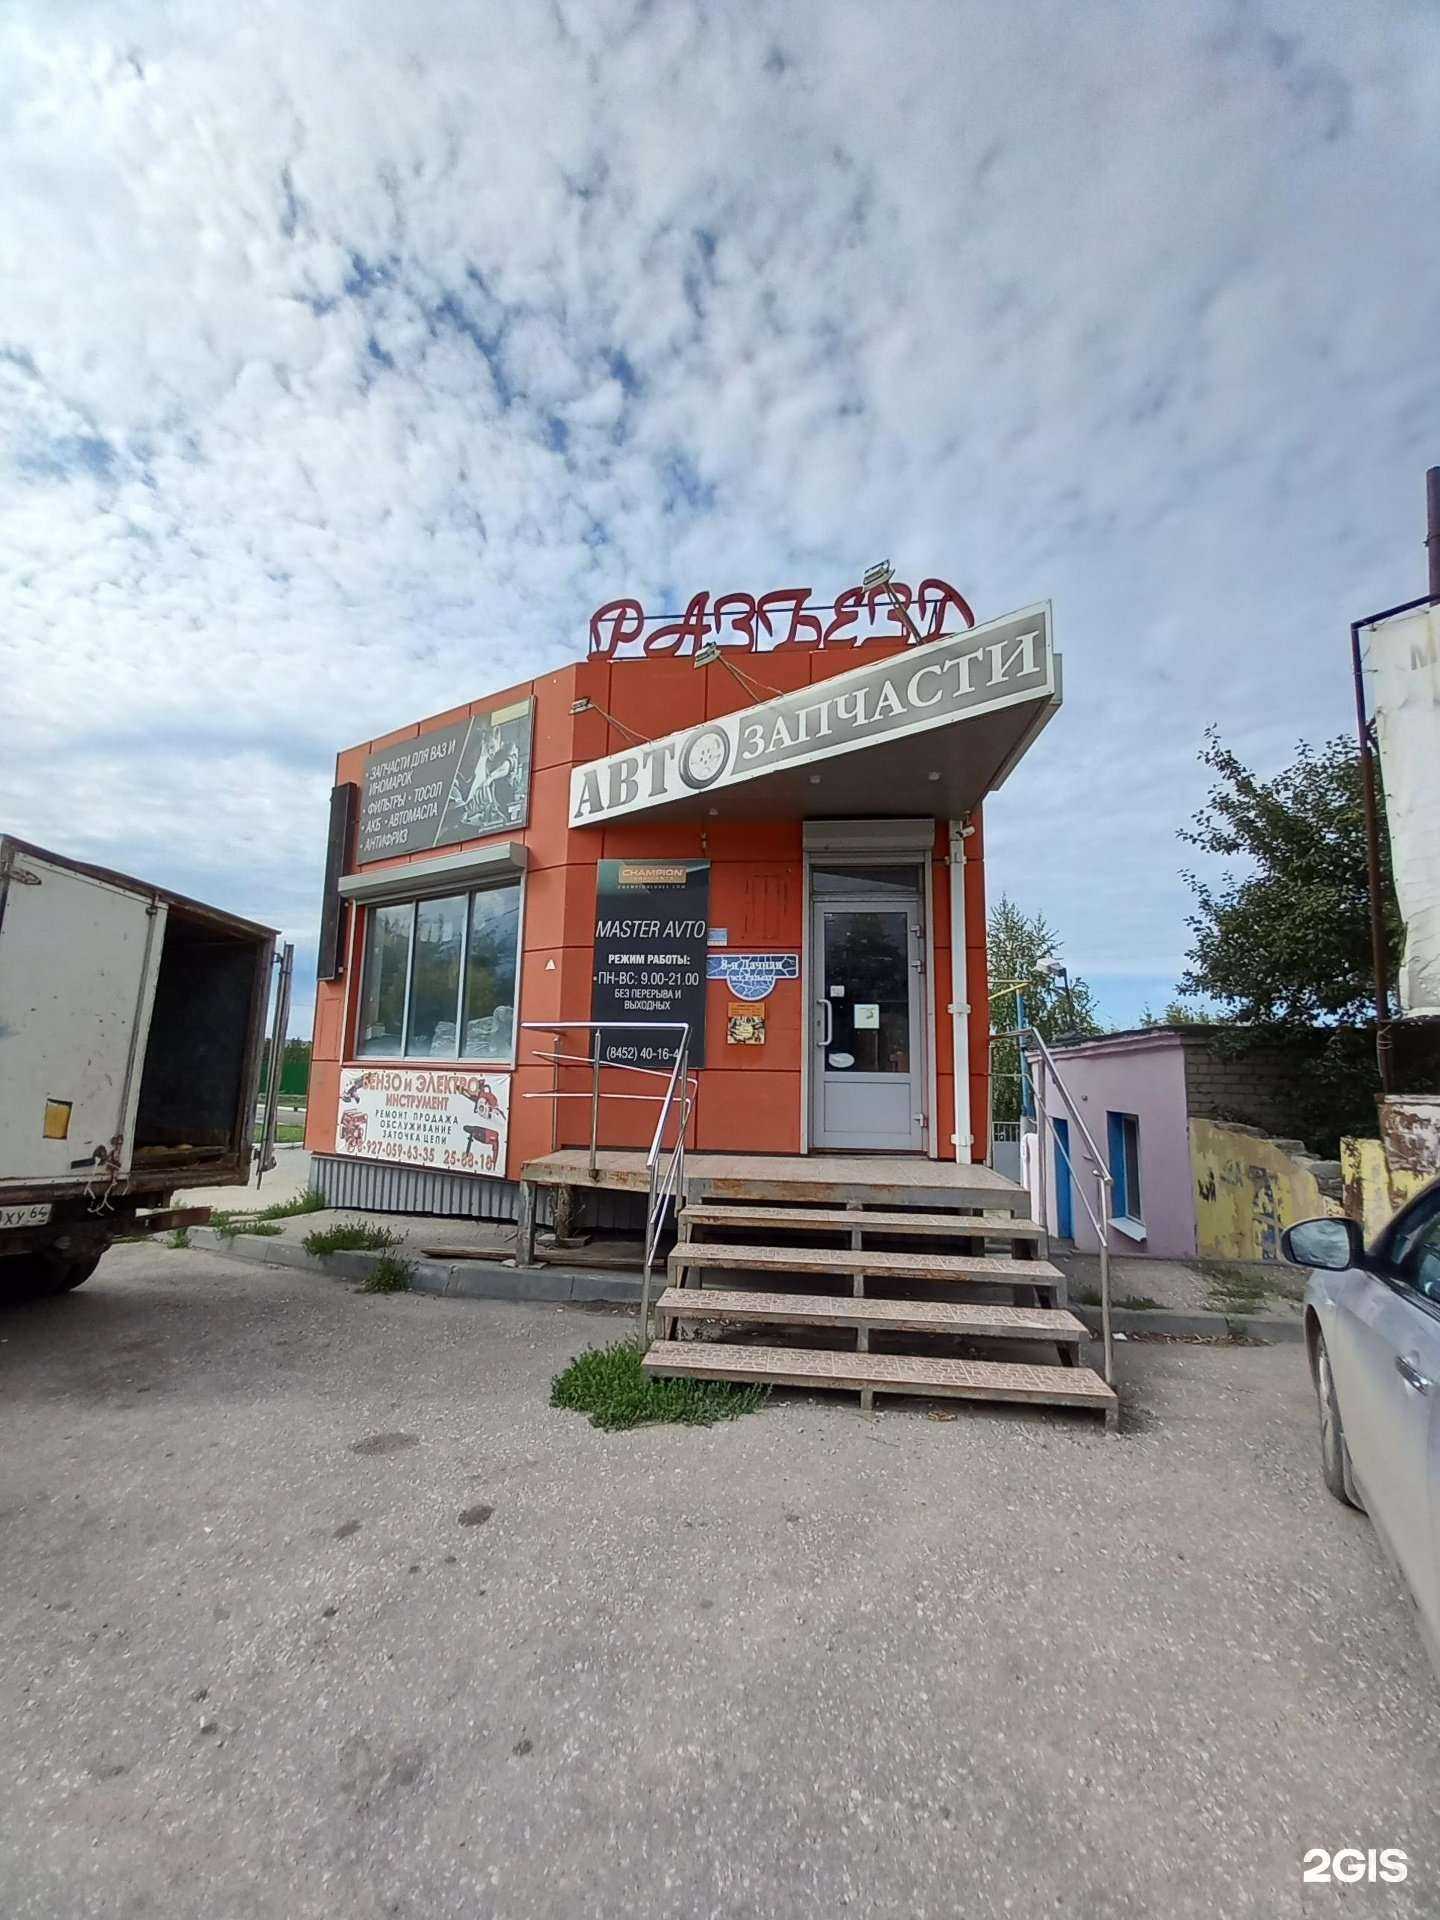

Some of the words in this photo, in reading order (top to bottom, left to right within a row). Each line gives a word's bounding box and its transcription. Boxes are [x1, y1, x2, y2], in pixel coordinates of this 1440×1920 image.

[370, 754, 410, 780] ЗАПЧАСТИ
[411, 748, 429, 769] ДЛЯ
[430, 743, 447, 761] ВАЗ
[369, 770, 413, 796] ИНОМАРОК
[367, 792, 406, 815] ФИЛЬТРЫ
[414, 782, 442, 803] ТОСОЛ
[365, 817, 381, 833] АКБ
[388, 802, 438, 827] АВТОМАСЛА
[364, 829, 408, 851] АНТИФРИЗ
[622, 868, 683, 876] CHAMPION
[596, 921, 660, 938] MASTER
[662, 921, 705, 938] AVTO
[608, 954, 645, 965] РЕЖИМ
[647, 954, 691, 965] РАБОТЫ:
[598, 972, 638, 985] ПН-ВС:
[640, 972, 699, 985] 9.00-21.00
[614, 989, 630, 998] БЕЗ
[631, 989, 673, 999] ПЕРЕРЫВА
[675, 990, 681, 999] И
[624, 1000, 671, 1010] ВЫХОДНЫХ
[606, 1046, 638, 1061] (8452)
[640, 1047, 682, 1060] 40-16-4
[362, 1072, 402, 1091] БЕНЗО
[415, 1074, 480, 1095] ЭЛЕКТРО
[385, 1093, 450, 1111] ИНСТРУМЕНТ
[375, 1109, 408, 1119] РЕМОНТ
[413, 1112, 458, 1124] ПРОДАЖА
[380, 1120, 451, 1134] ОБСЛУЖИВАНИЕ
[382, 1130, 420, 1142] ЗАТОЧКА
[423, 1134, 447, 1144] ЦЕПИ
